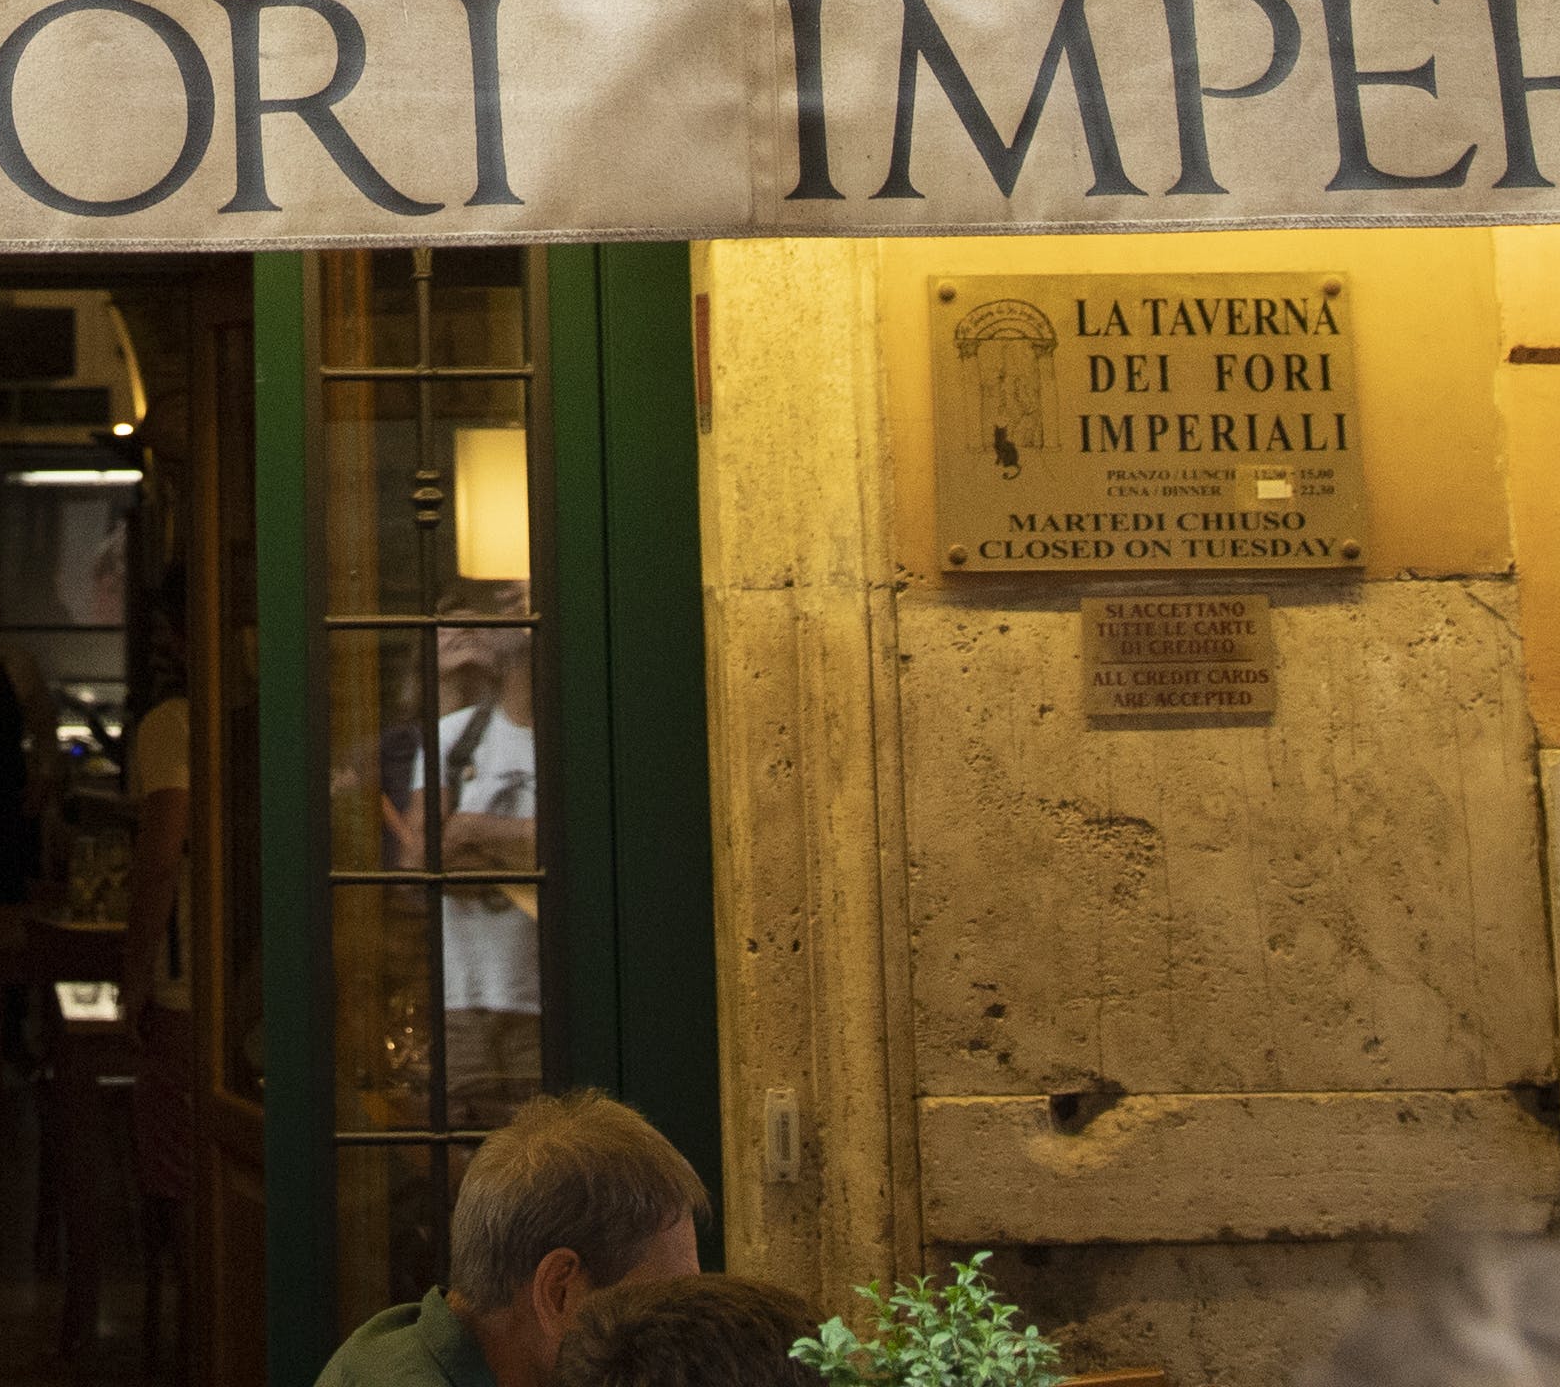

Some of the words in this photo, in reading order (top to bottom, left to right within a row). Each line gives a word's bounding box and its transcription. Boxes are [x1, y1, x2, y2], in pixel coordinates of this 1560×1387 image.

[1076, 298, 1132, 337] LA
[1142, 297, 1341, 336] TAVERNA
[1088, 354, 1171, 393] DEI
[1213, 353, 1333, 392] FORI
[1078, 412, 1350, 453] IMPERIALI
[1008, 512, 1165, 532] MARTEDI
[1176, 511, 1306, 531] CHIUSO
[978, 539, 1115, 560] CLOSED
[1125, 539, 1172, 559] ON
[1182, 537, 1336, 558] TUESDAY
[1131, 601, 1246, 618] ACCETTANO
[1194, 620, 1257, 635] CARTE
[1149, 638, 1235, 655] CREDITO
[1094, 671, 1130, 686] ALL
[1132, 670, 1201, 686] CREDIT
[1207, 668, 1270, 685] CARDS
[1155, 690, 1253, 707] ACCEPTED
